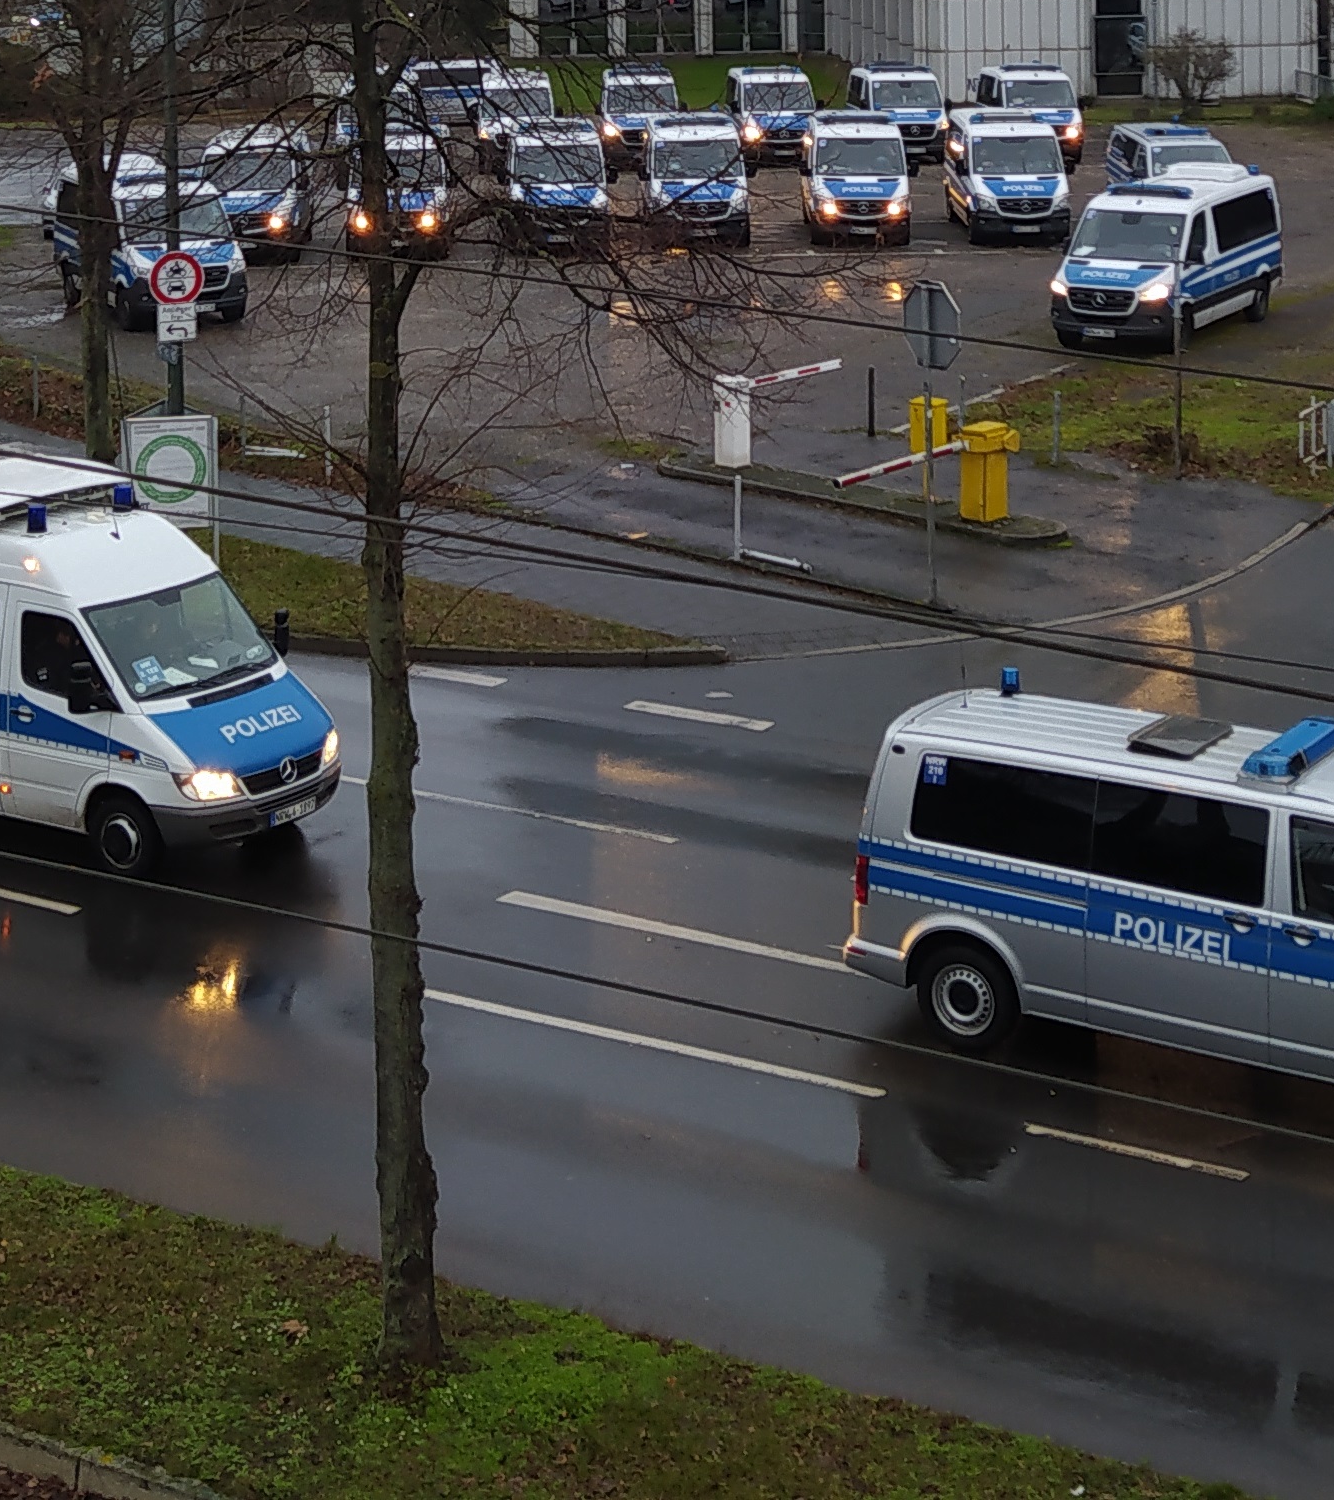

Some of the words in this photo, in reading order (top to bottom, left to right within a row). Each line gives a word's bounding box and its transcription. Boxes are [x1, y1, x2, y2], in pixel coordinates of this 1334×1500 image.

[841, 186, 884, 194] POLIZEI
[1002, 184, 1045, 193] POLIZEI
[1080, 270, 1131, 281] POLIZEI
[219, 704, 302, 744] POLIZEI
[1114, 911, 1231, 961] POLIZEI
